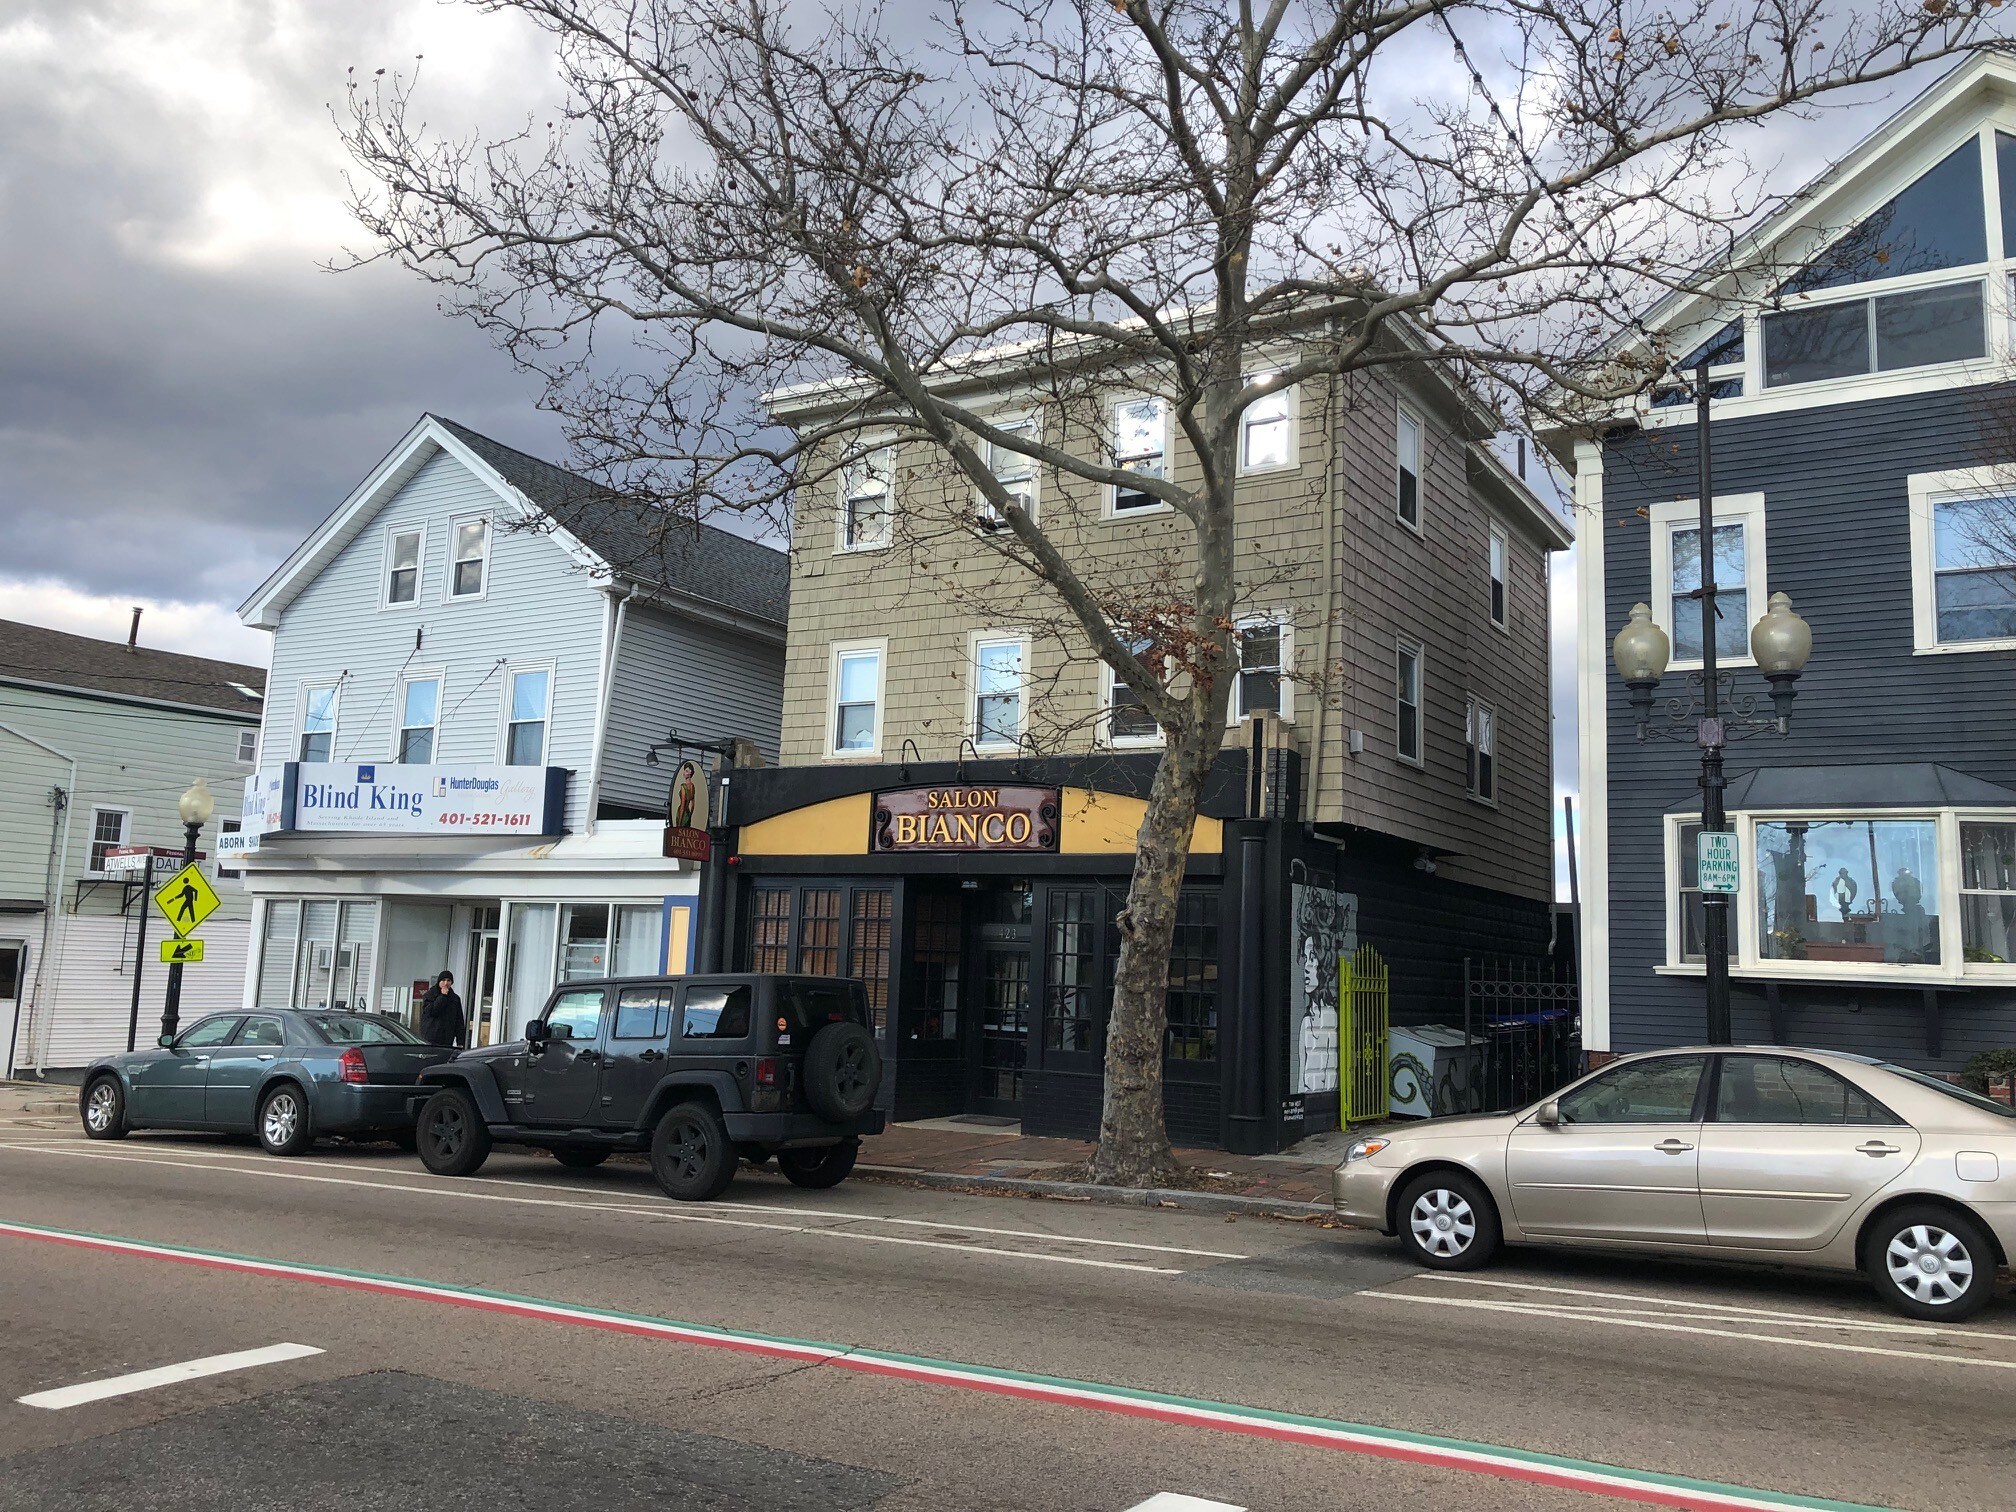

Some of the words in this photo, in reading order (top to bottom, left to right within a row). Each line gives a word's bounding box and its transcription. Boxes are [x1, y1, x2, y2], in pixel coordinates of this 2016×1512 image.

[303, 784, 360, 809] Blind
[369, 785, 423, 817] King
[928, 790, 998, 809] SALON
[439, 813, 531, 826] 401-521-1611
[678, 829, 699, 838] SALON
[895, 813, 1032, 844] BIANCO
[219, 837, 245, 849] ABORN
[671, 836, 706, 850] BIANCO
[1710, 836, 1728, 848] TWO
[1707, 848, 1731, 860] HOUR
[106, 856, 136, 869] ATWELLS
[1701, 860, 1737, 872] PARKING
[1703, 872, 1736, 882] 8AM-6PM
